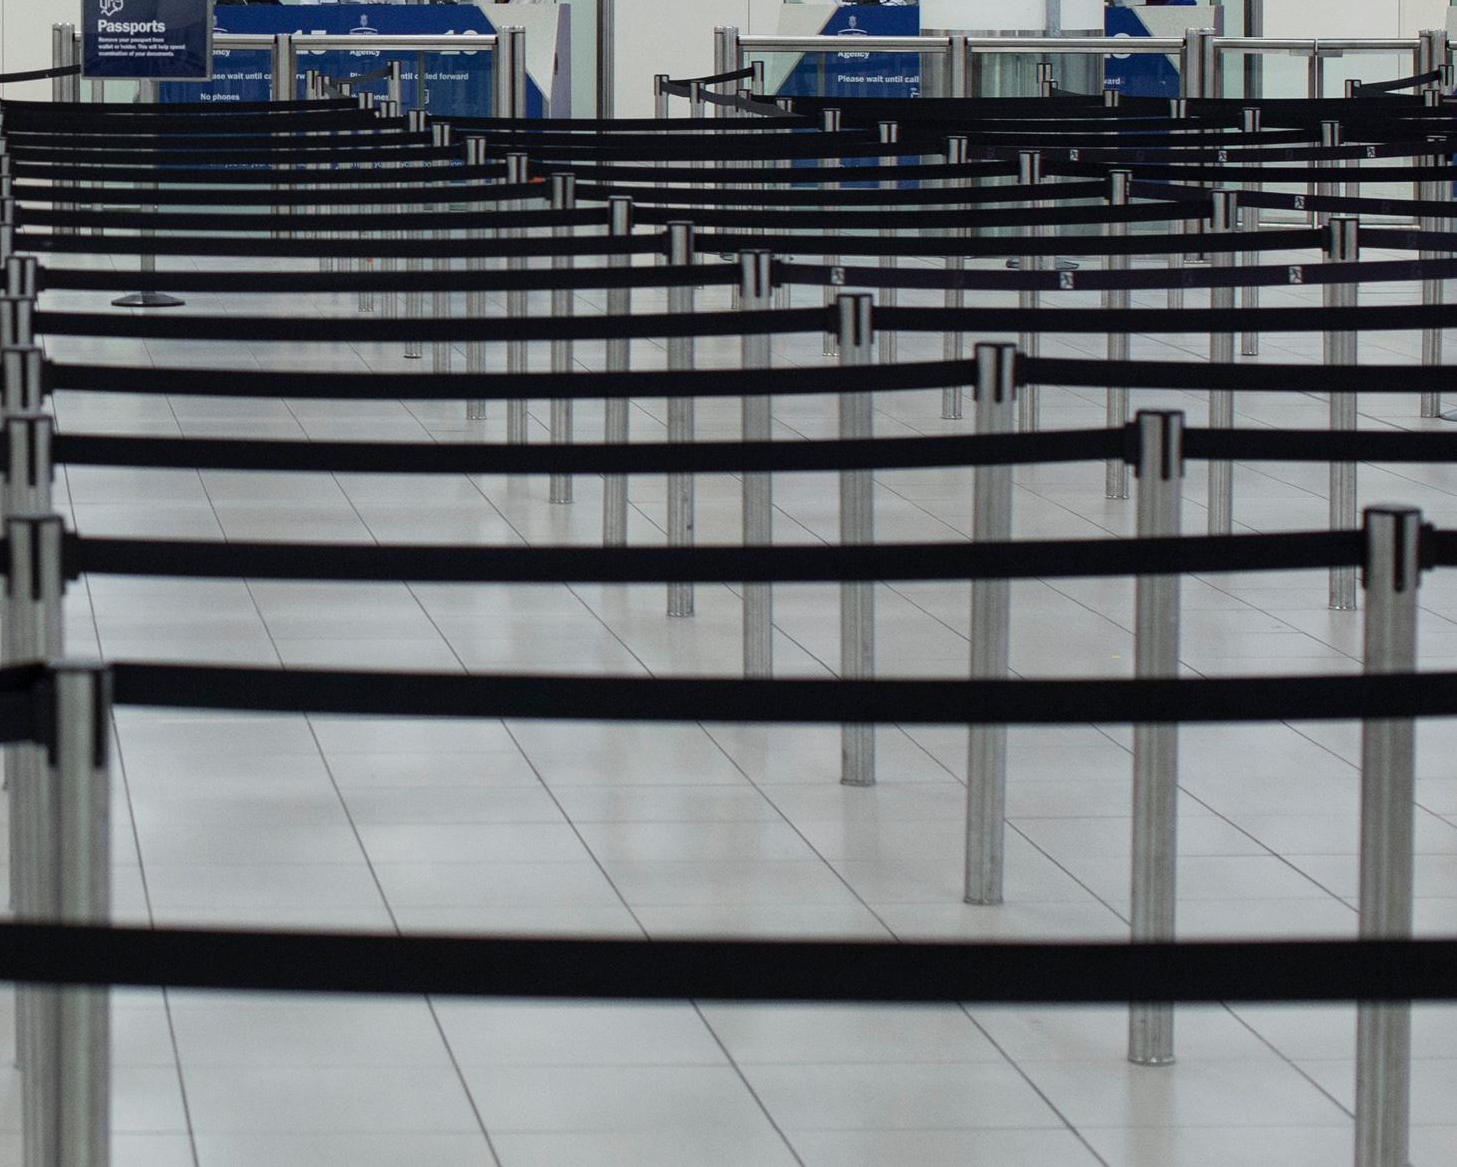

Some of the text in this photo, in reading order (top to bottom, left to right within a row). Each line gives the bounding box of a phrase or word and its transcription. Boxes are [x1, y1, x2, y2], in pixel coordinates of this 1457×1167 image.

[98, 19, 166, 35] Passports
[838, 75, 920, 83] Please wait until call
[200, 93, 240, 102] No phones
